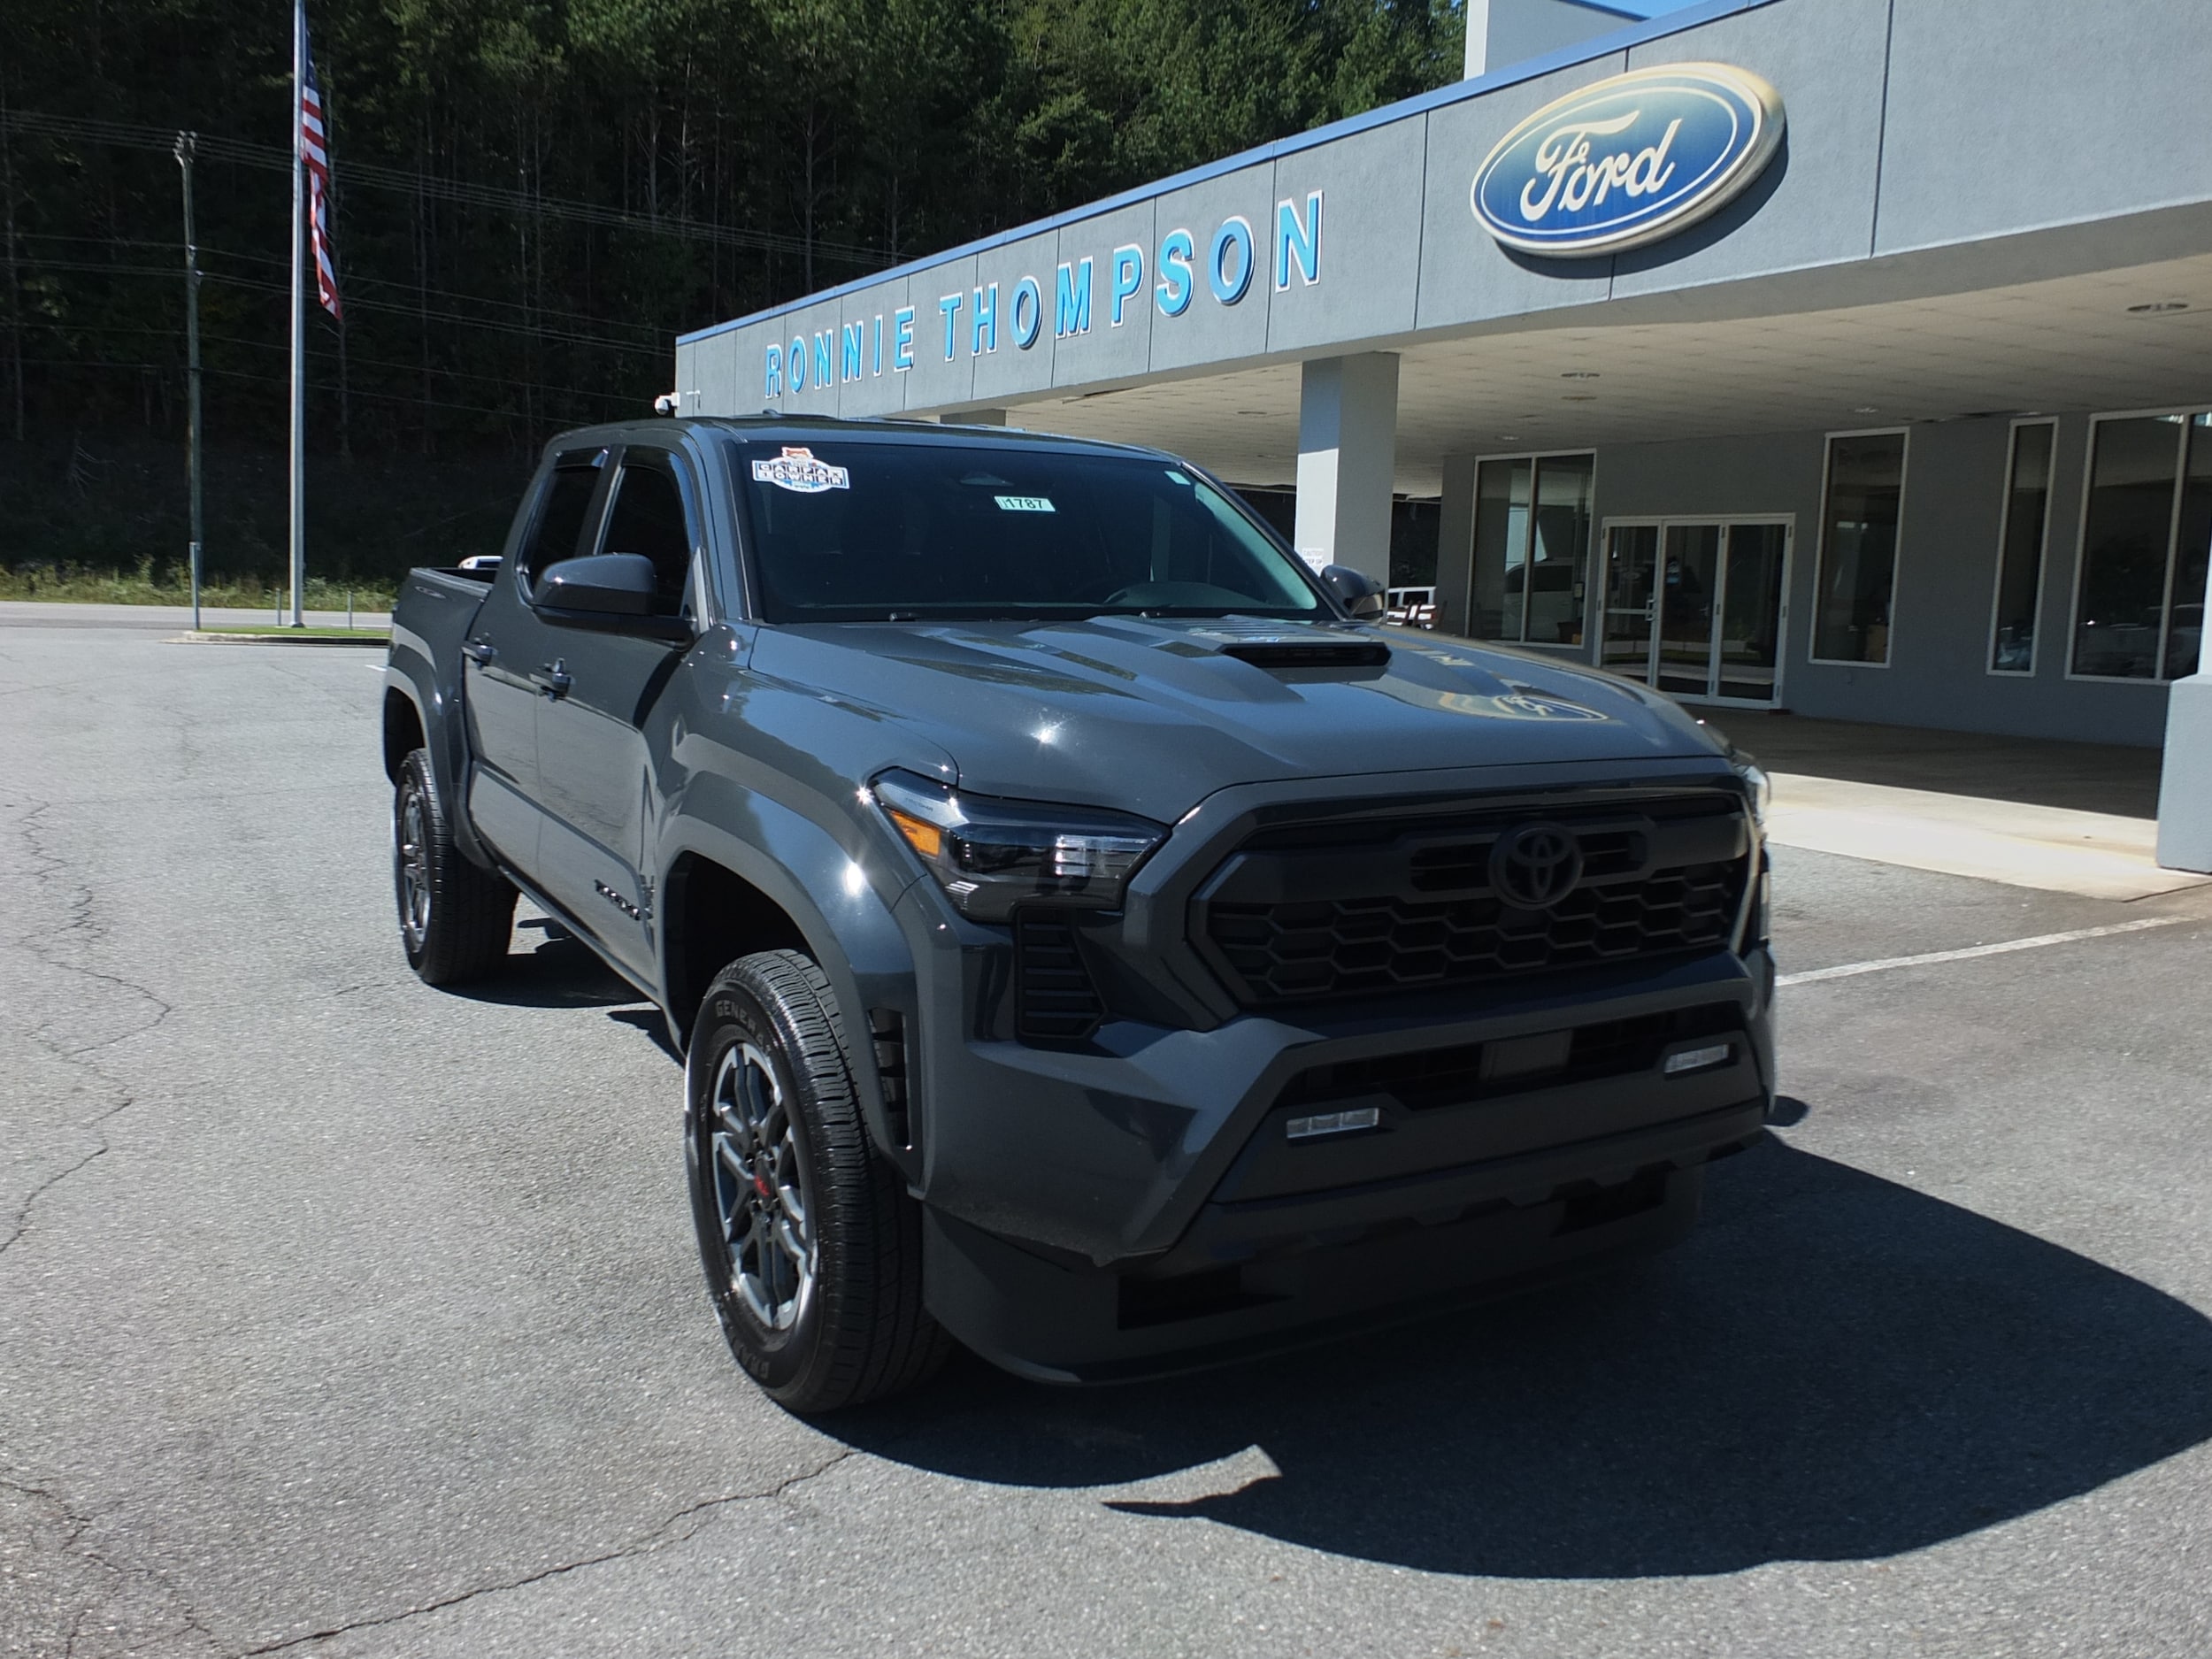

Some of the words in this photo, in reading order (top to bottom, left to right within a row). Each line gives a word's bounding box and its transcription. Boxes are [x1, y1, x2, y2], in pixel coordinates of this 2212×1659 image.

[1519, 110, 1682, 221] Ford
[764, 305, 917, 399] RONNIE
[938, 189, 1324, 363] THOMPSON
